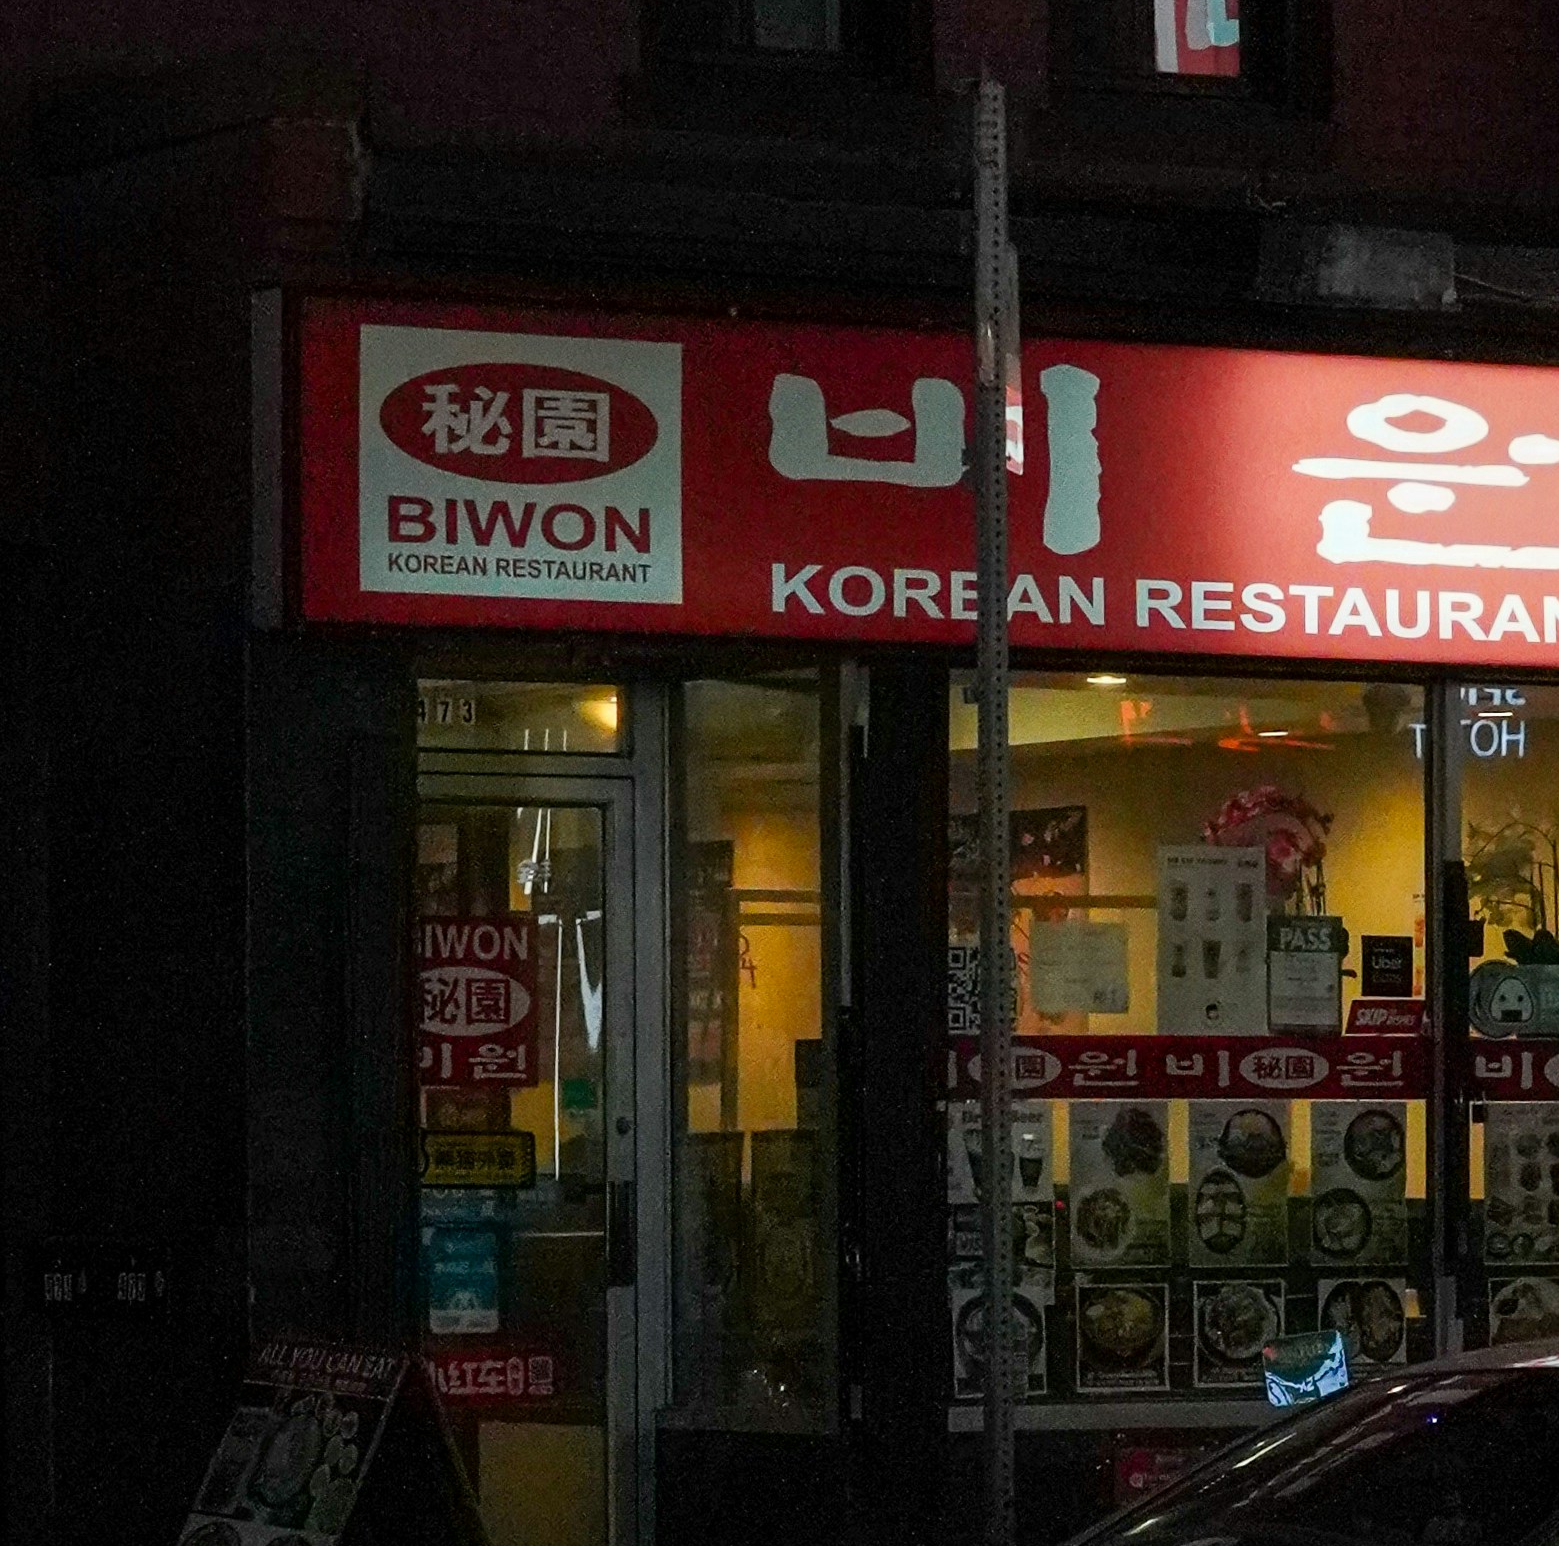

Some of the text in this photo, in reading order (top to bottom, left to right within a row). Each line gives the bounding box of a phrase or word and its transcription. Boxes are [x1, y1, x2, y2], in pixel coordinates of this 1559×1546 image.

[422, 382, 610, 463] 秘園
[388, 495, 651, 553] BIWON
[388, 553, 651, 583] KOREAN RESTAURANT
[771, 562, 1105, 626] KOREAN
[417, 923, 528, 961] IWON
[1280, 925, 1333, 951] PASS
